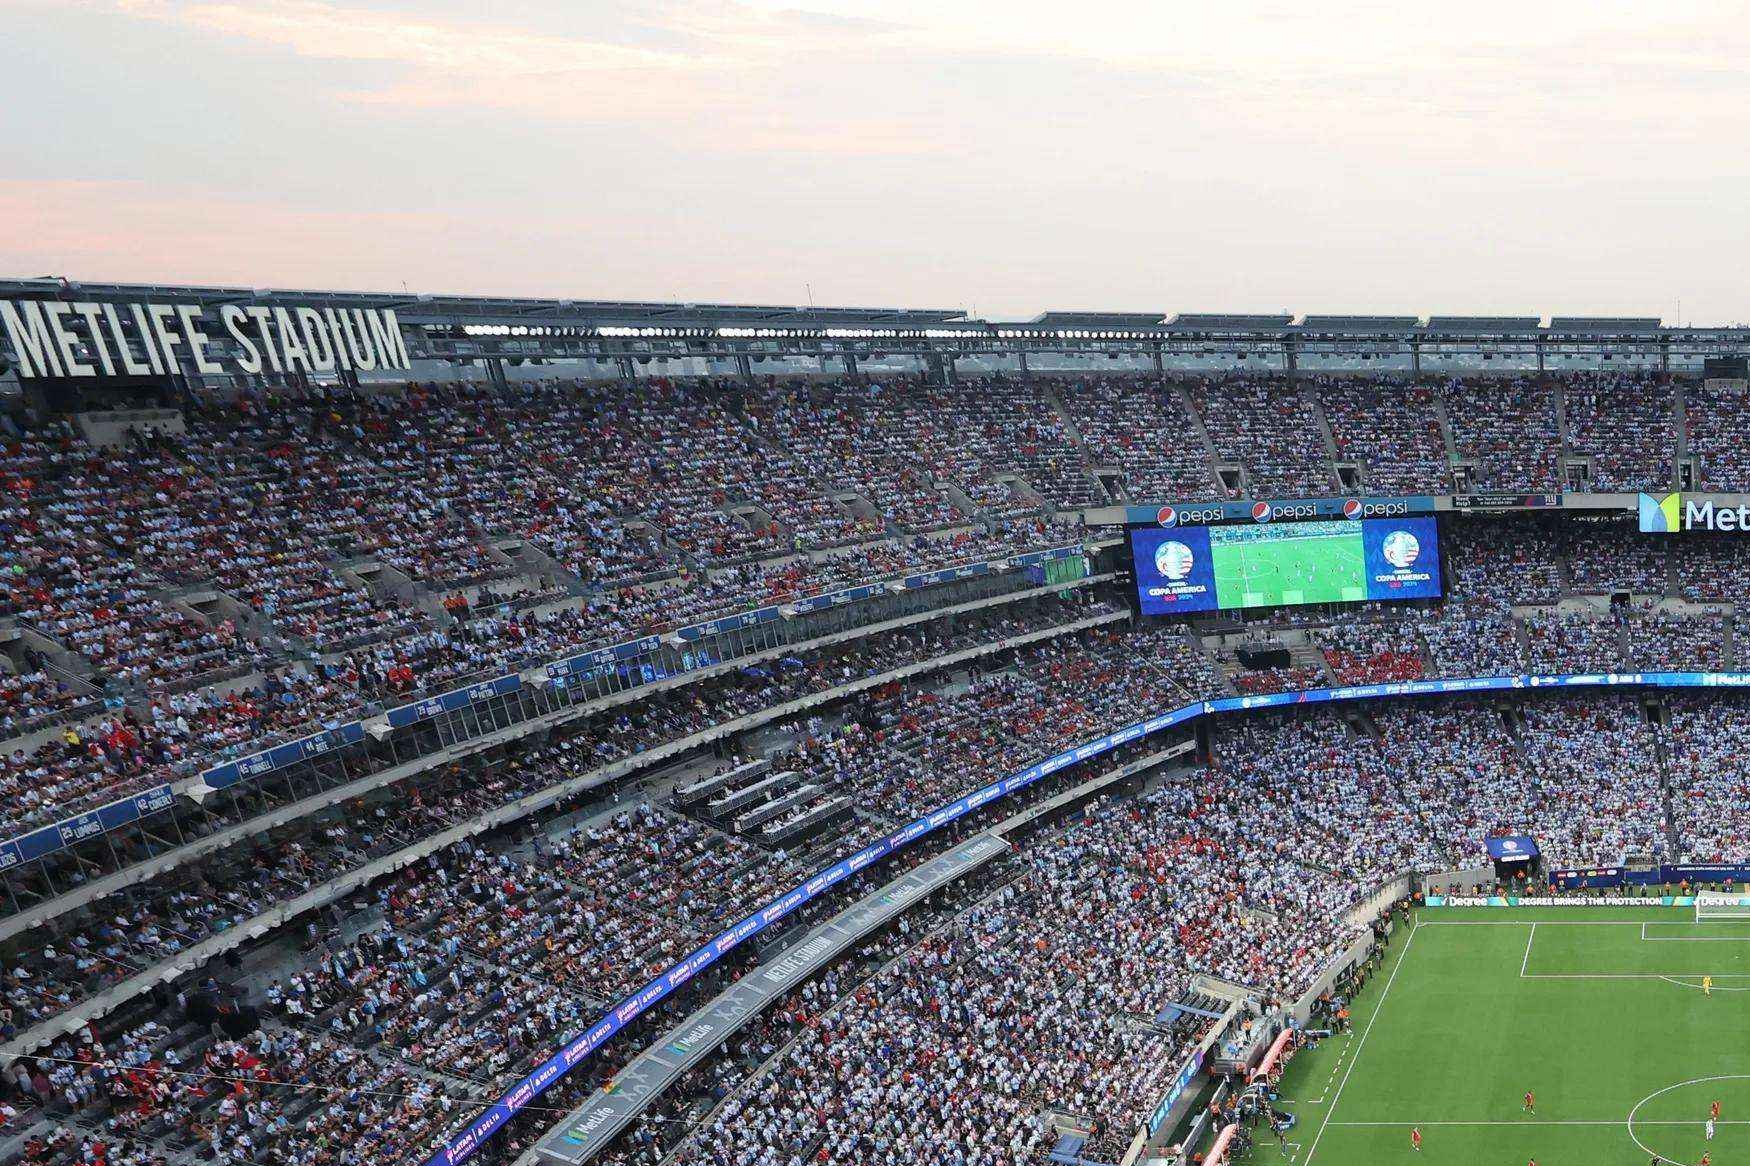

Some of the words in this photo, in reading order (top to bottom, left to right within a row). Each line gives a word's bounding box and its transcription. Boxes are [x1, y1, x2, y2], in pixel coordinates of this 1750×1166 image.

[0, 300, 224, 377] METLIFE
[221, 304, 410, 373] STADIUM
[1179, 507, 1224, 526] pepsi
[1273, 503, 1316, 522] pepsi
[1364, 500, 1408, 519] pepsi
[1449, 896, 1488, 907] Degree
[1518, 898, 1552, 906] DEGREE
[1552, 897, 1586, 906] BRINGS
[1587, 897, 1606, 906] THE
[1606, 897, 1662, 906] PROTECTION
[1701, 896, 1739, 907] Degree
[763, 952, 801, 982] METLIFE
[797, 936, 834, 970] STADIUM
[684, 1022, 714, 1050] MetLife
[575, 1106, 615, 1134] MetLife
[452, 1134, 473, 1155] LATAM
[482, 1113, 500, 1132] DELTA
